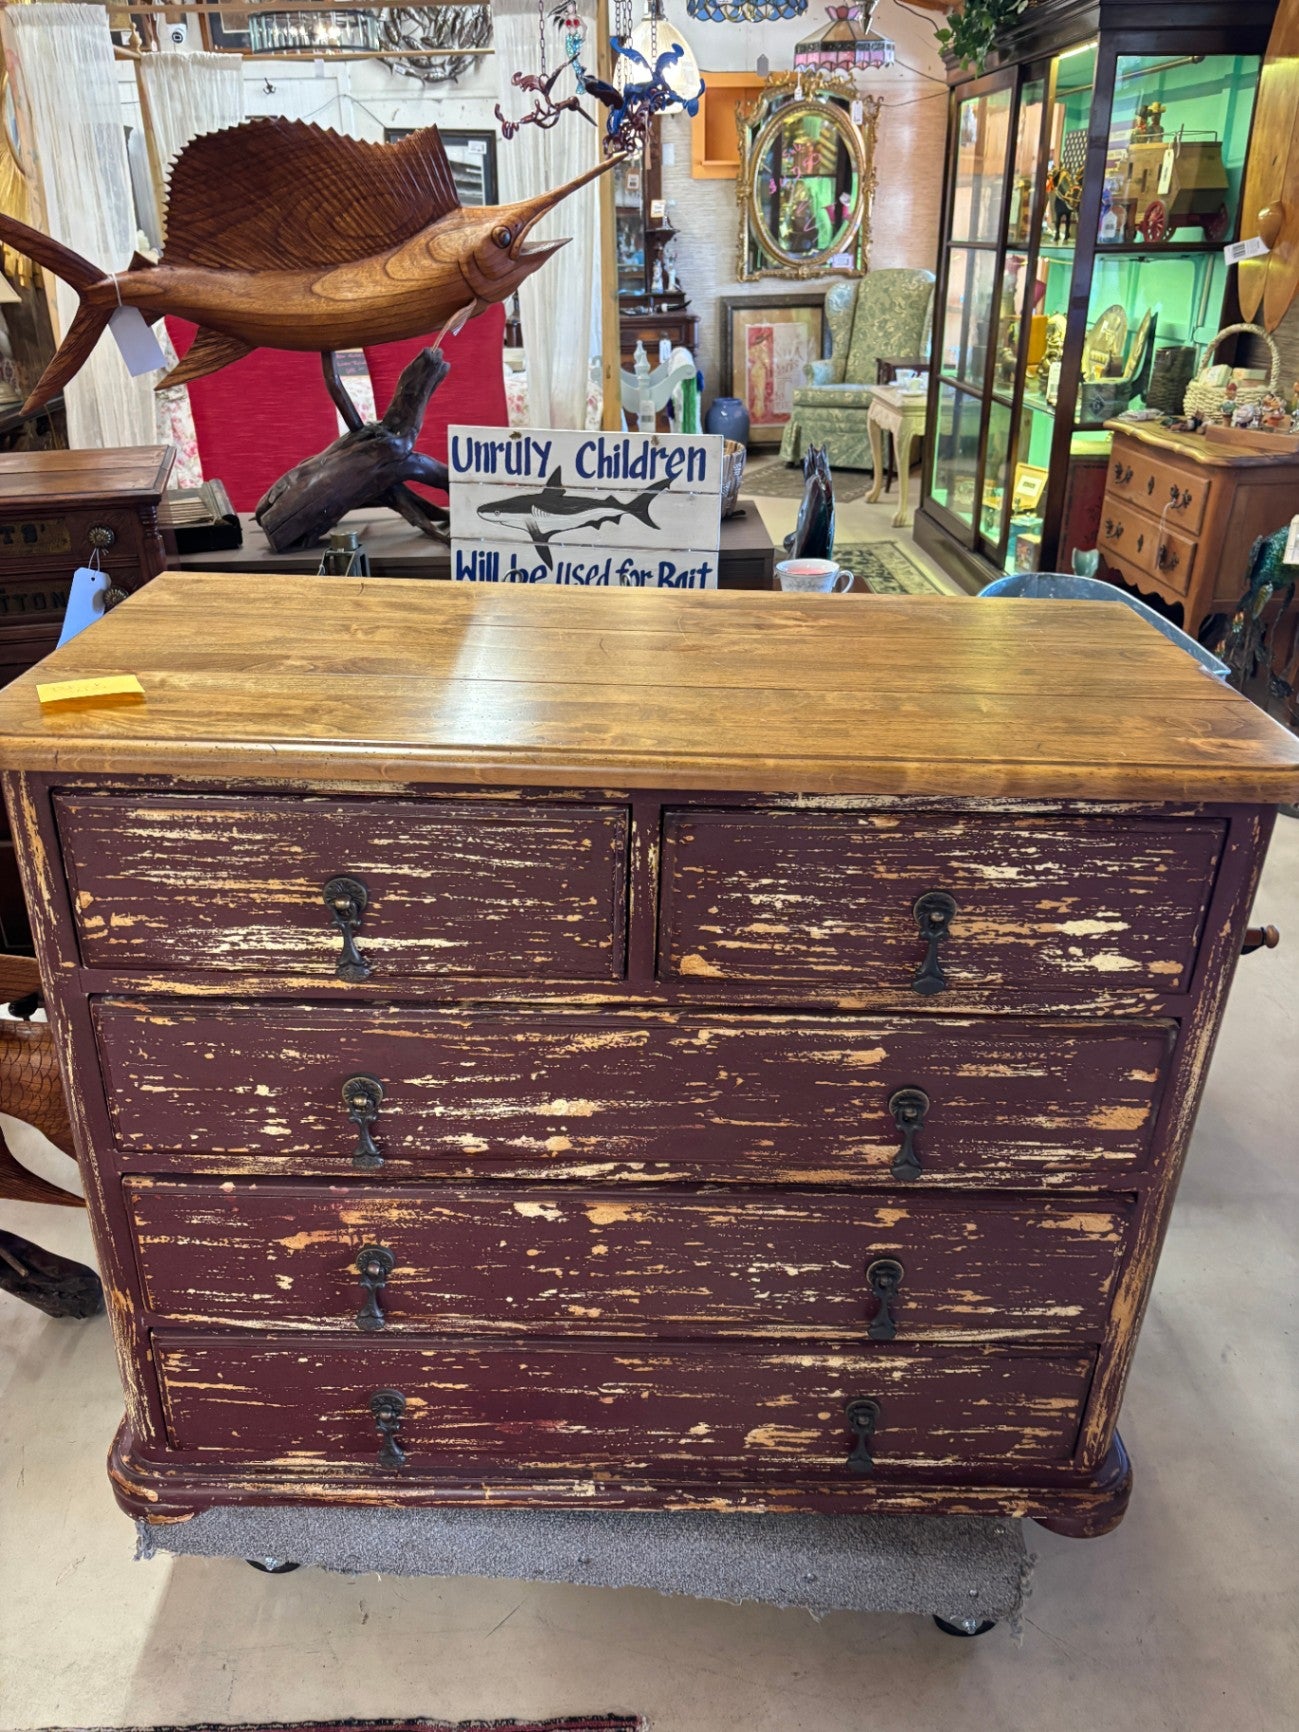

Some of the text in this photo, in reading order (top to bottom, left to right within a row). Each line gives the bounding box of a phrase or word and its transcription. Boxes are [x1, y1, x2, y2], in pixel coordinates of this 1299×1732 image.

[452, 435, 706, 482] Unruly Children
[456, 550, 499, 582] Will
[510, 553, 547, 583] be
[615, 558, 653, 587] for
[658, 561, 713, 589] Bait
